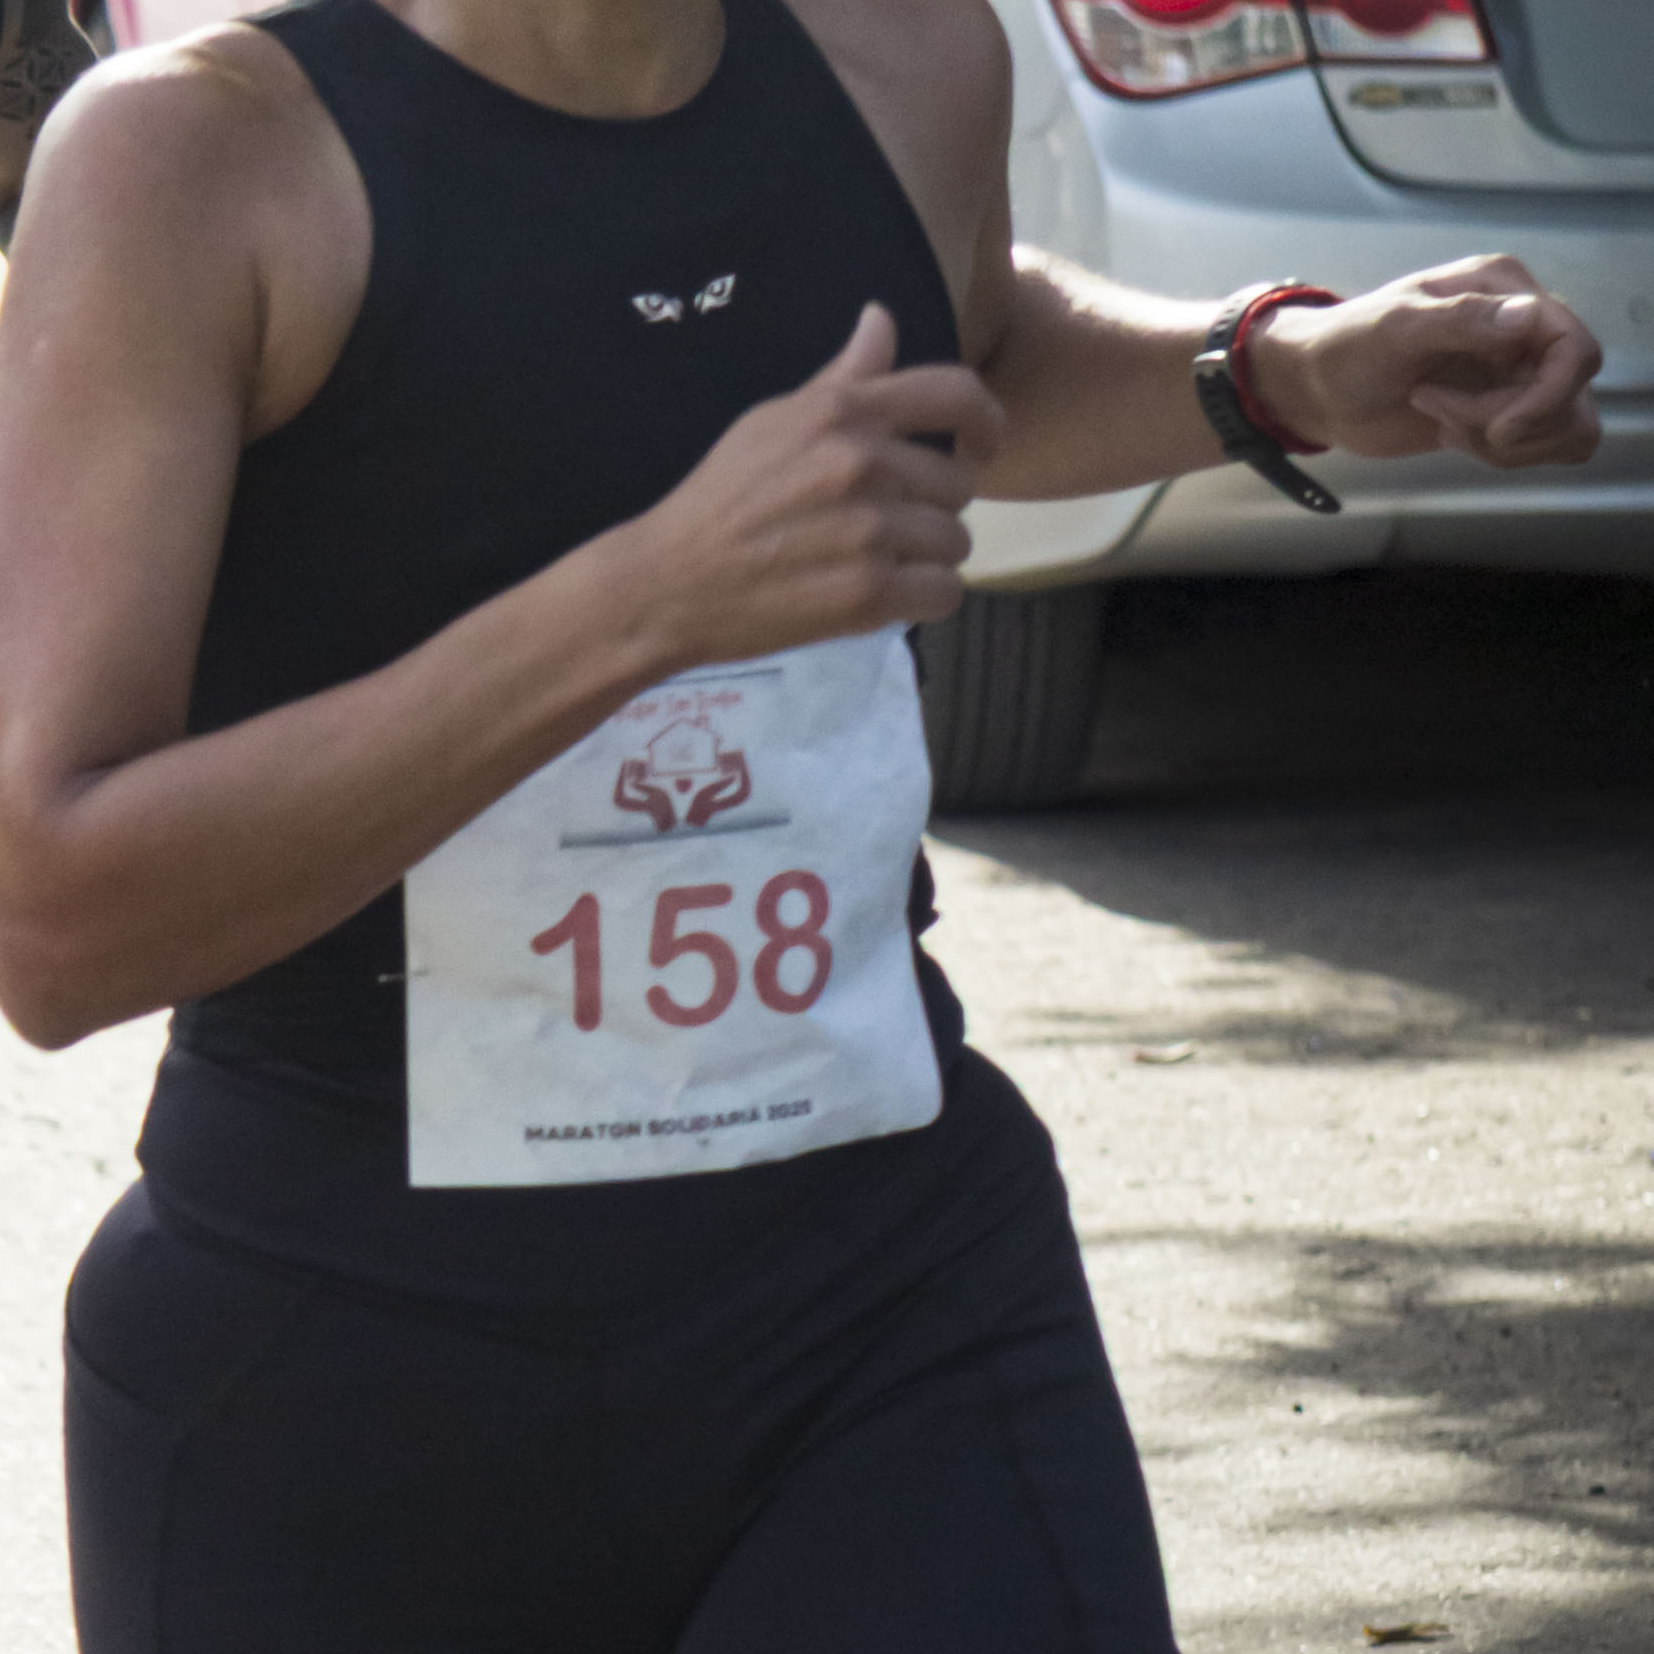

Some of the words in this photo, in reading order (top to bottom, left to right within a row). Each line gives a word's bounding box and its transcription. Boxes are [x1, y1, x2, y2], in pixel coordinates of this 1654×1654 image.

[530, 869, 834, 1032] 158
[524, 1121, 642, 1142] MARATON
[647, 1105, 761, 1136] SOLIDARIA
